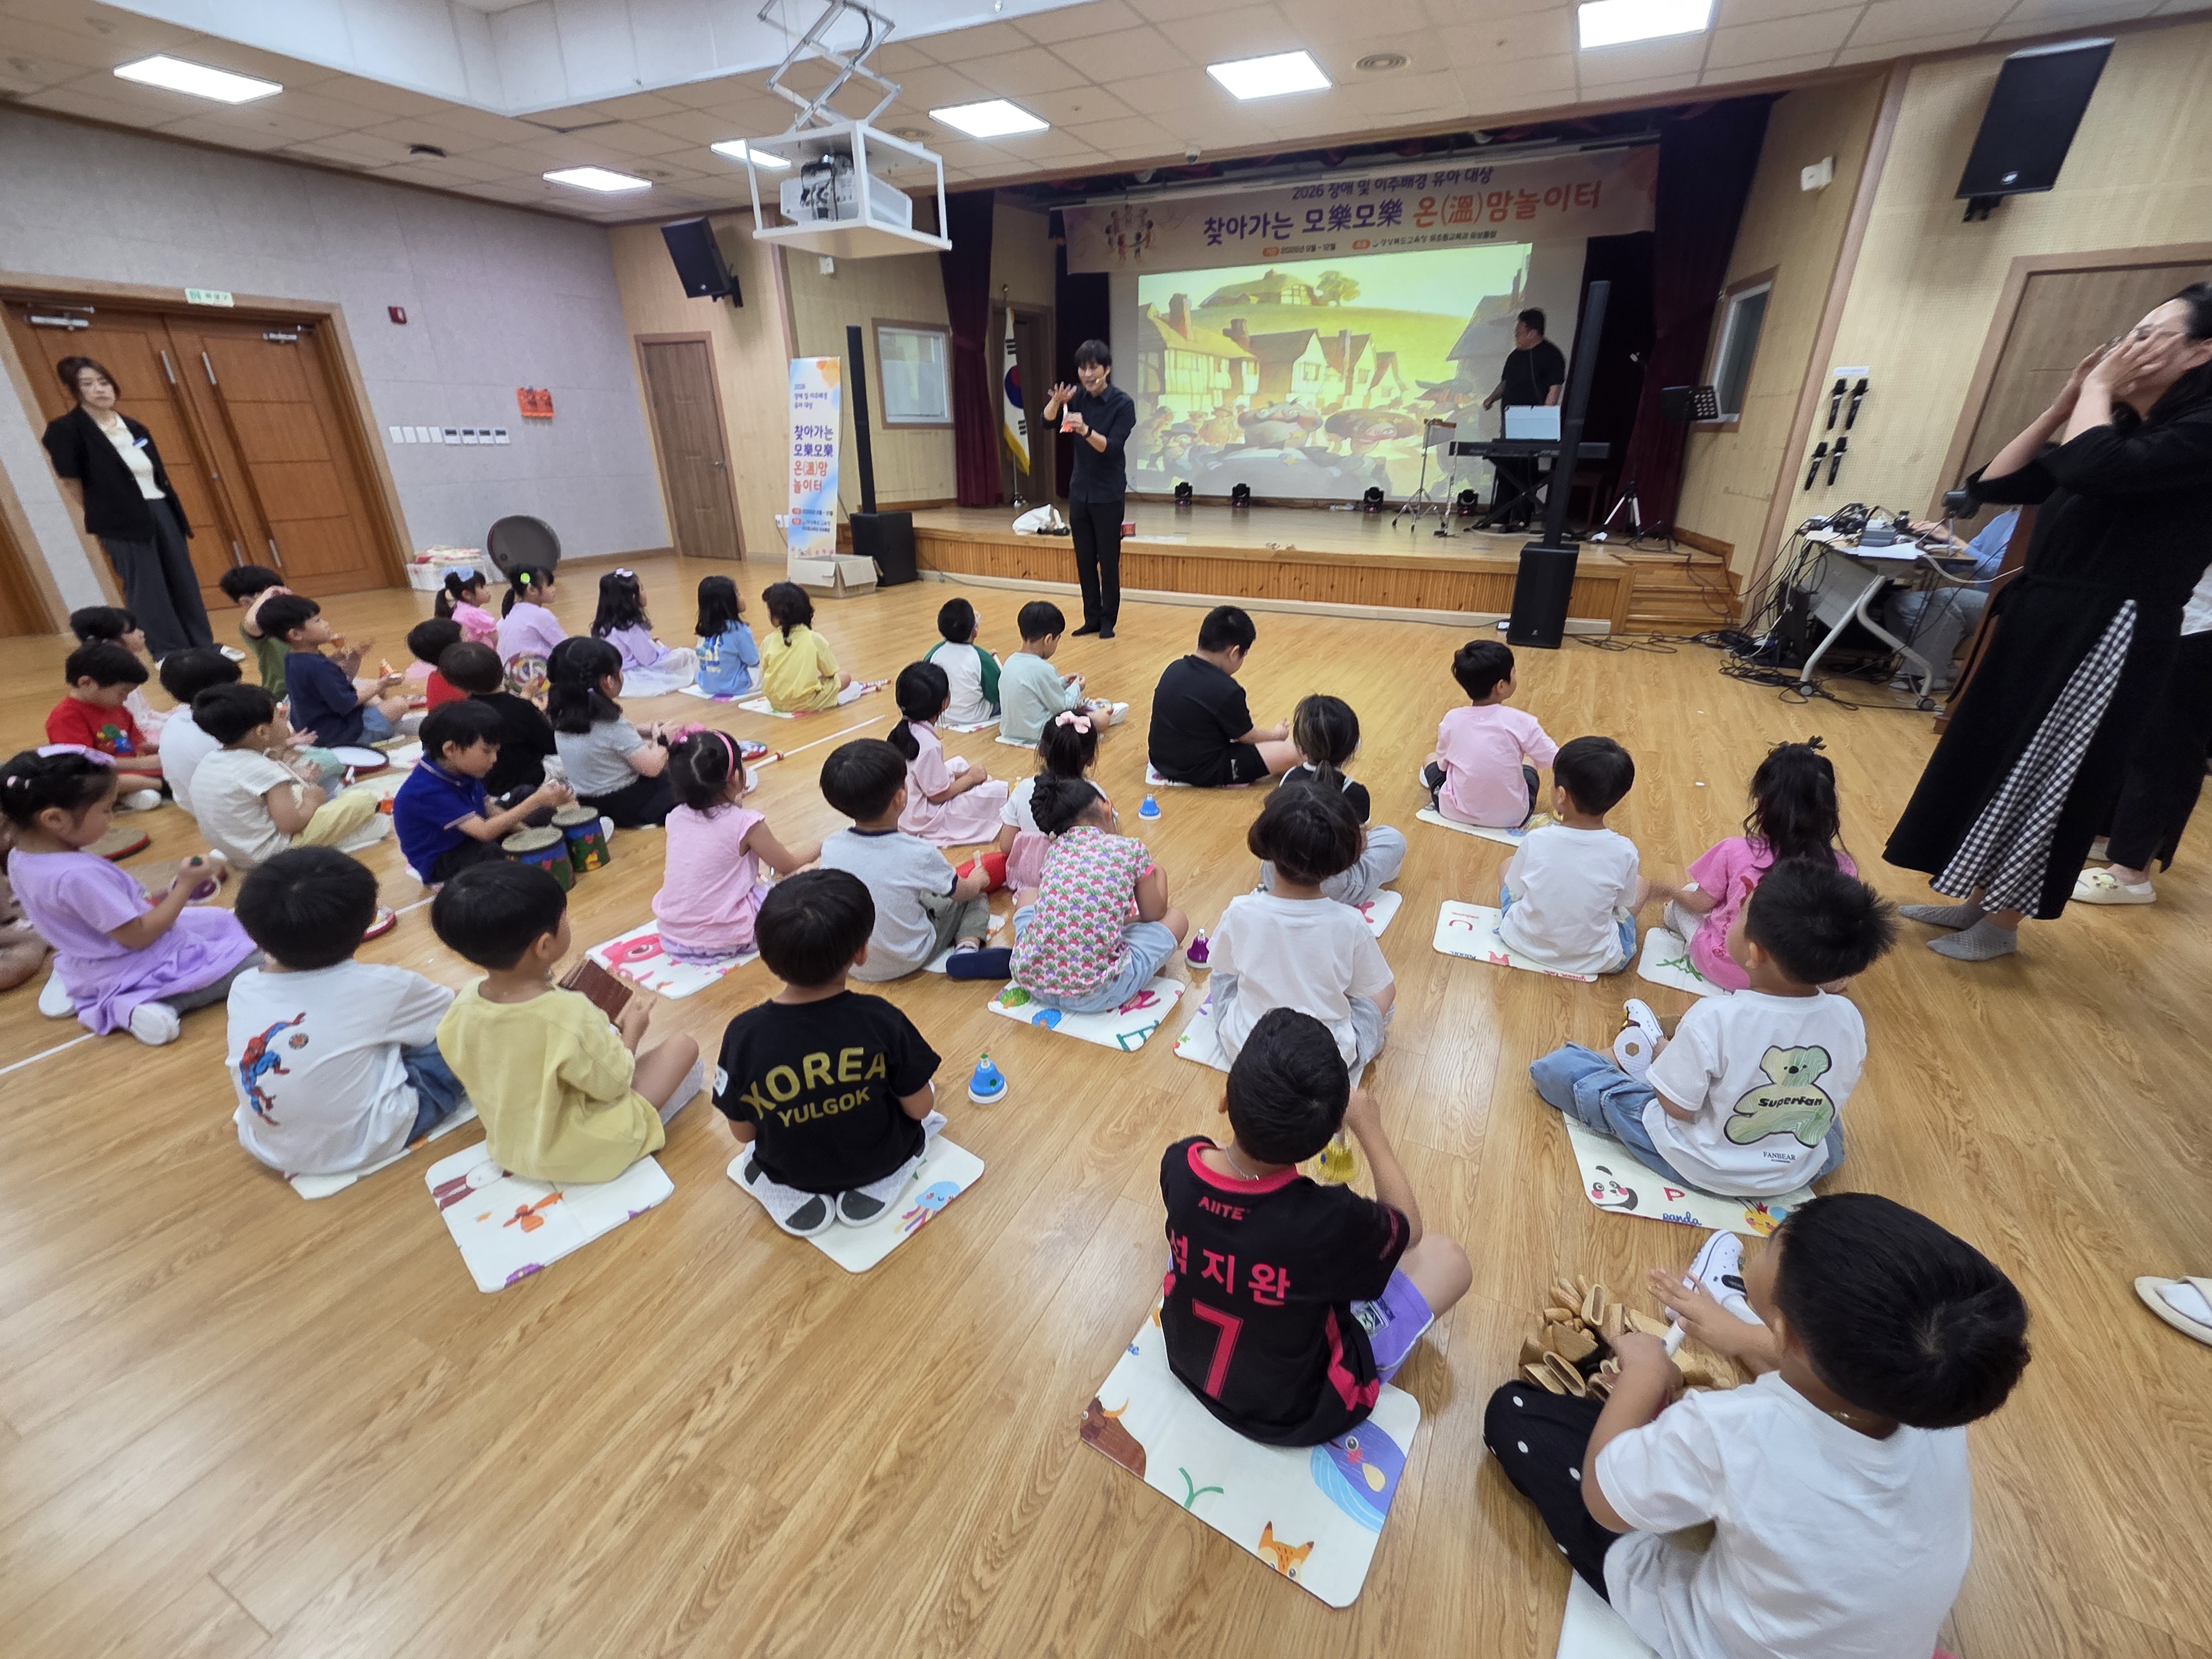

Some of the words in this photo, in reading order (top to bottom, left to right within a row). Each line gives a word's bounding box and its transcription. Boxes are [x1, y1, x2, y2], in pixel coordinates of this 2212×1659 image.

[1292, 184, 1324, 200] 2026
[1328, 181, 1354, 199] 장애
[1358, 179, 1370, 196] 및
[1374, 174, 1427, 192] 이주배경
[1432, 169, 1462, 187] 유아
[1465, 166, 1494, 184] 대상
[1204, 211, 1294, 247] 찾아가는
[794, 425, 833, 441] 찾아가는
[793, 478, 822, 494] 놀이터
[740, 1047, 885, 1120] KOREA
[777, 1086, 870, 1128] YULGOK
[1763, 1151, 1796, 1161] FANBEAR
[1663, 1187, 1685, 1201] P
[1663, 1211, 1702, 1225] panda
[1192, 1297, 1244, 1400] 7
